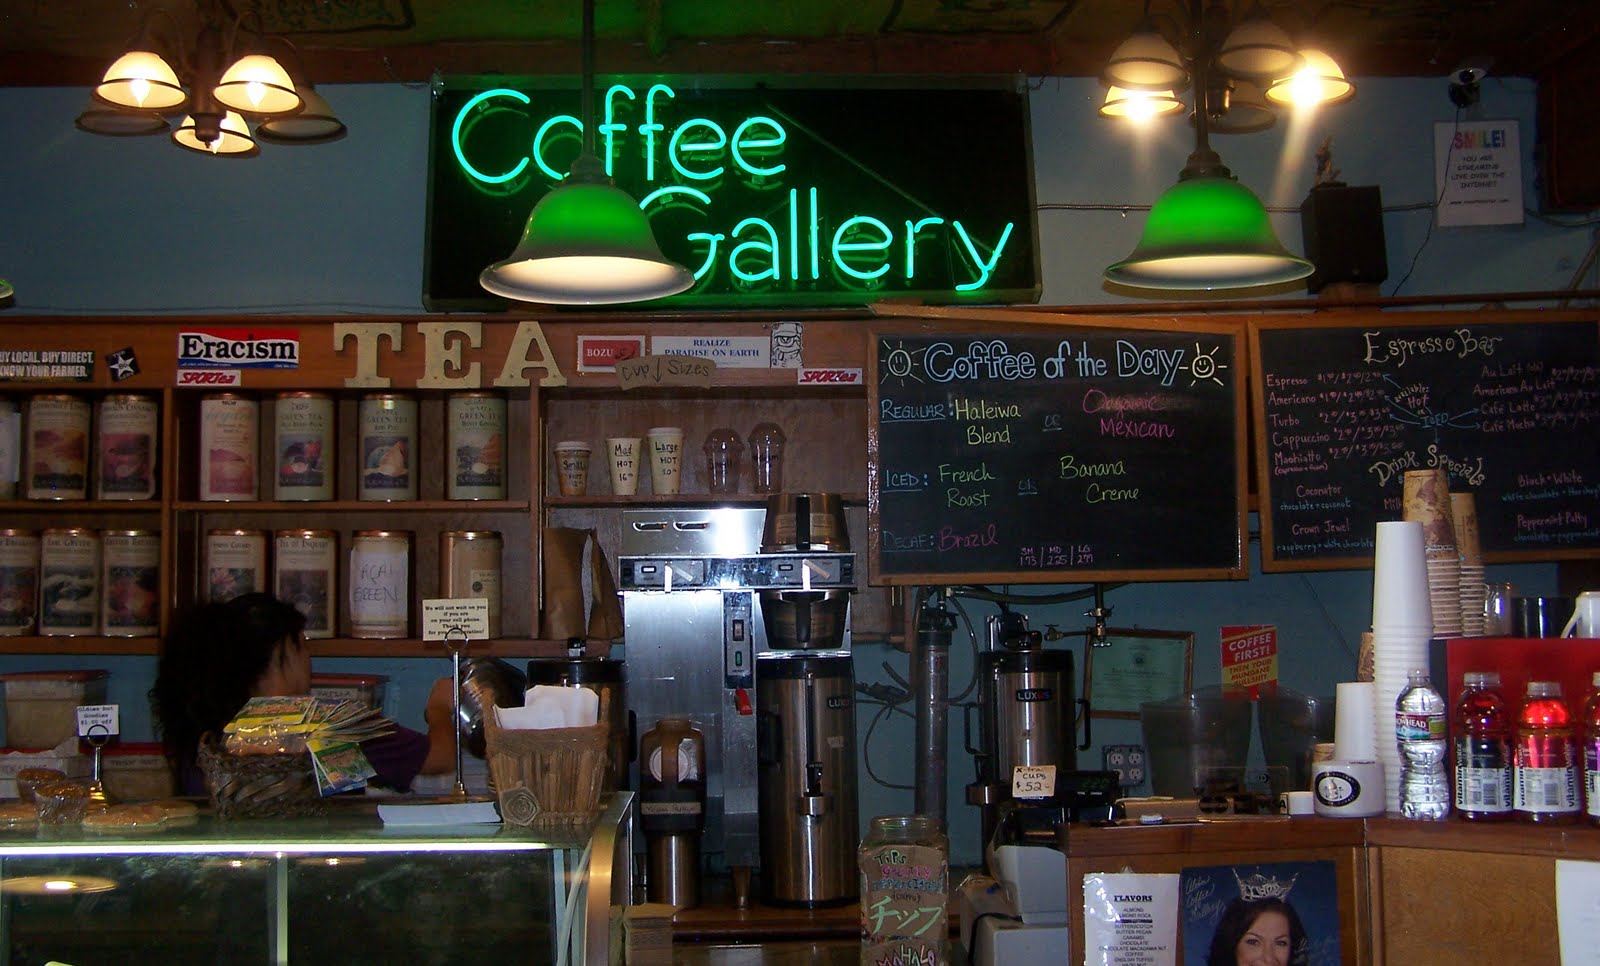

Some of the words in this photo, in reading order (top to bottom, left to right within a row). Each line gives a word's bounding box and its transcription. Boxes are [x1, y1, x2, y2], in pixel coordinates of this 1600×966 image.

[452, 83, 787, 184] Coffee
[1455, 130, 1505, 149] SMILE!
[639, 185, 1014, 292] Gallery
[181, 333, 297, 359] Eracism
[587, 348, 613, 357] BOZU
[664, 348, 710, 358] PARADISE
[729, 347, 759, 357] EARTH
[693, 339, 731, 347] REALIZE
[1363, 331, 1456, 368] Espresso
[1454, 328, 1503, 358] Bar
[42, 352, 60, 363] BUY
[334, 321, 567, 388] TEA
[923, 340, 1036, 383] Coffee
[1043, 341, 1070, 379] of
[1075, 341, 1108, 377] the
[1116, 340, 1185, 386] Day
[0, 366, 26, 377] KNOW
[26, 366, 50, 377] YOUR
[667, 359, 710, 377] Sizes
[1266, 373, 1308, 390] Espresso
[1268, 392, 1316, 406] Americano
[953, 398, 1022, 422] Haleiwa
[1268, 413, 1300, 428] Turbo
[966, 424, 1012, 446] Blend
[1100, 418, 1176, 440] Mexican
[1272, 431, 1330, 450] Cappuccino
[614, 443, 633, 457] Med
[655, 441, 679, 454] Large
[616, 460, 633, 468] HOT
[660, 456, 678, 465] HOT
[938, 462, 996, 484] French
[1060, 455, 1128, 480] Banana
[1368, 449, 1420, 488] Drink
[1427, 443, 1486, 487] Specials
[947, 487, 991, 508] Roast
[1085, 484, 1140, 504] Creme
[936, 523, 999, 550] Brazil
[1228, 632, 1272, 652] COFFEE
[1234, 644, 1270, 662] FIRST!
